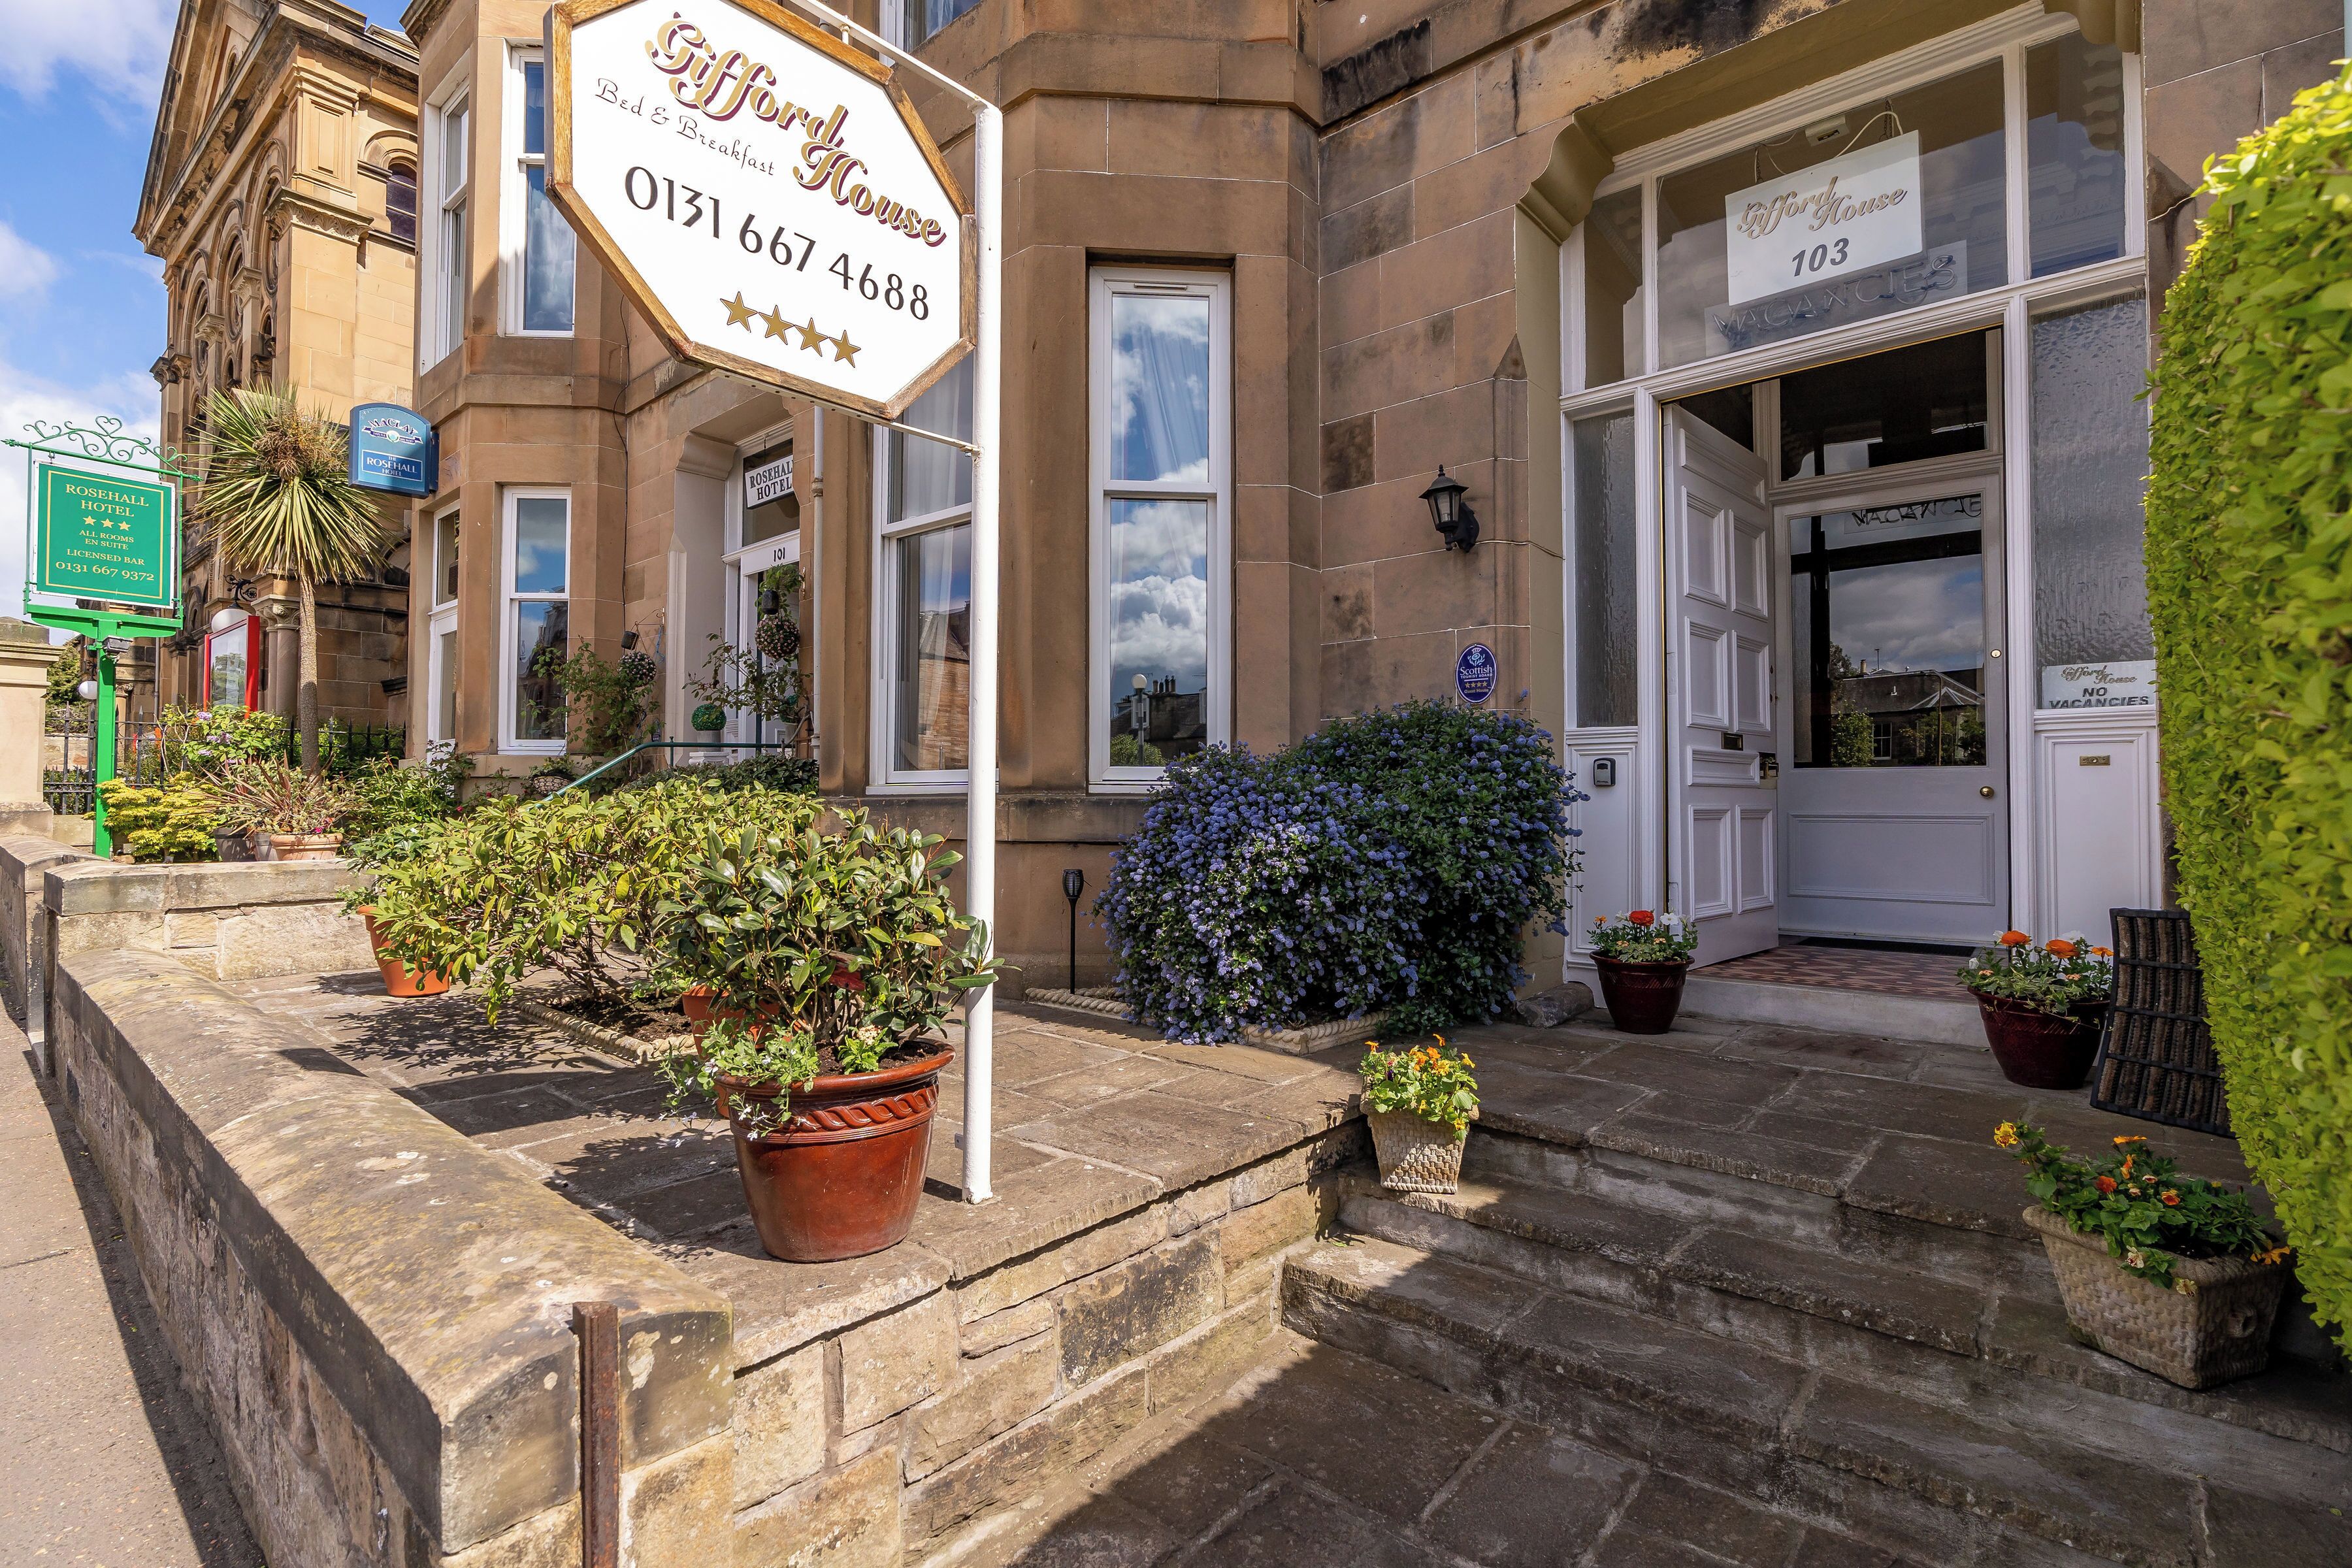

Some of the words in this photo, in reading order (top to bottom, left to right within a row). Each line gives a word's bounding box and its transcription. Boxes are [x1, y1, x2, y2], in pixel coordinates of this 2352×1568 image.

[644, 11, 849, 148] Gifford
[595, 78, 645, 116] Bed
[651, 106, 670, 125] &
[676, 115, 774, 176] Breakfast
[792, 135, 947, 248] House
[1737, 176, 1838, 239] Gifford
[1808, 188, 1908, 231] House
[625, 166, 720, 239] 0131
[739, 213, 817, 272] 667
[828, 252, 930, 321] 4688
[1792, 238, 1849, 277] 103
[367, 457, 418, 474] ROSEHALL
[382, 468, 402, 477] HOTEL
[749, 459, 794, 489] ROSEHAL
[65, 483, 150, 507] ROSEHALL
[757, 476, 792, 501] HOTEL
[80, 500, 135, 517] HOTEL
[100, 532, 135, 543] ROOMS
[101, 541, 129, 550] SUITE
[67, 549, 122, 562] LICENSED
[124, 557, 145, 566] BAR
[774, 547, 785, 562] 101
[56, 561, 88, 573] 0131
[92, 564, 118, 578] 667
[122, 570, 155, 581] 9372
[1460, 664, 1492, 676] Scottish
[2061, 665, 2107, 681] Gifford
[2094, 673, 2137, 684] House
[2082, 687, 2108, 698] NO
[2049, 696, 2149, 710] VACANCIES
